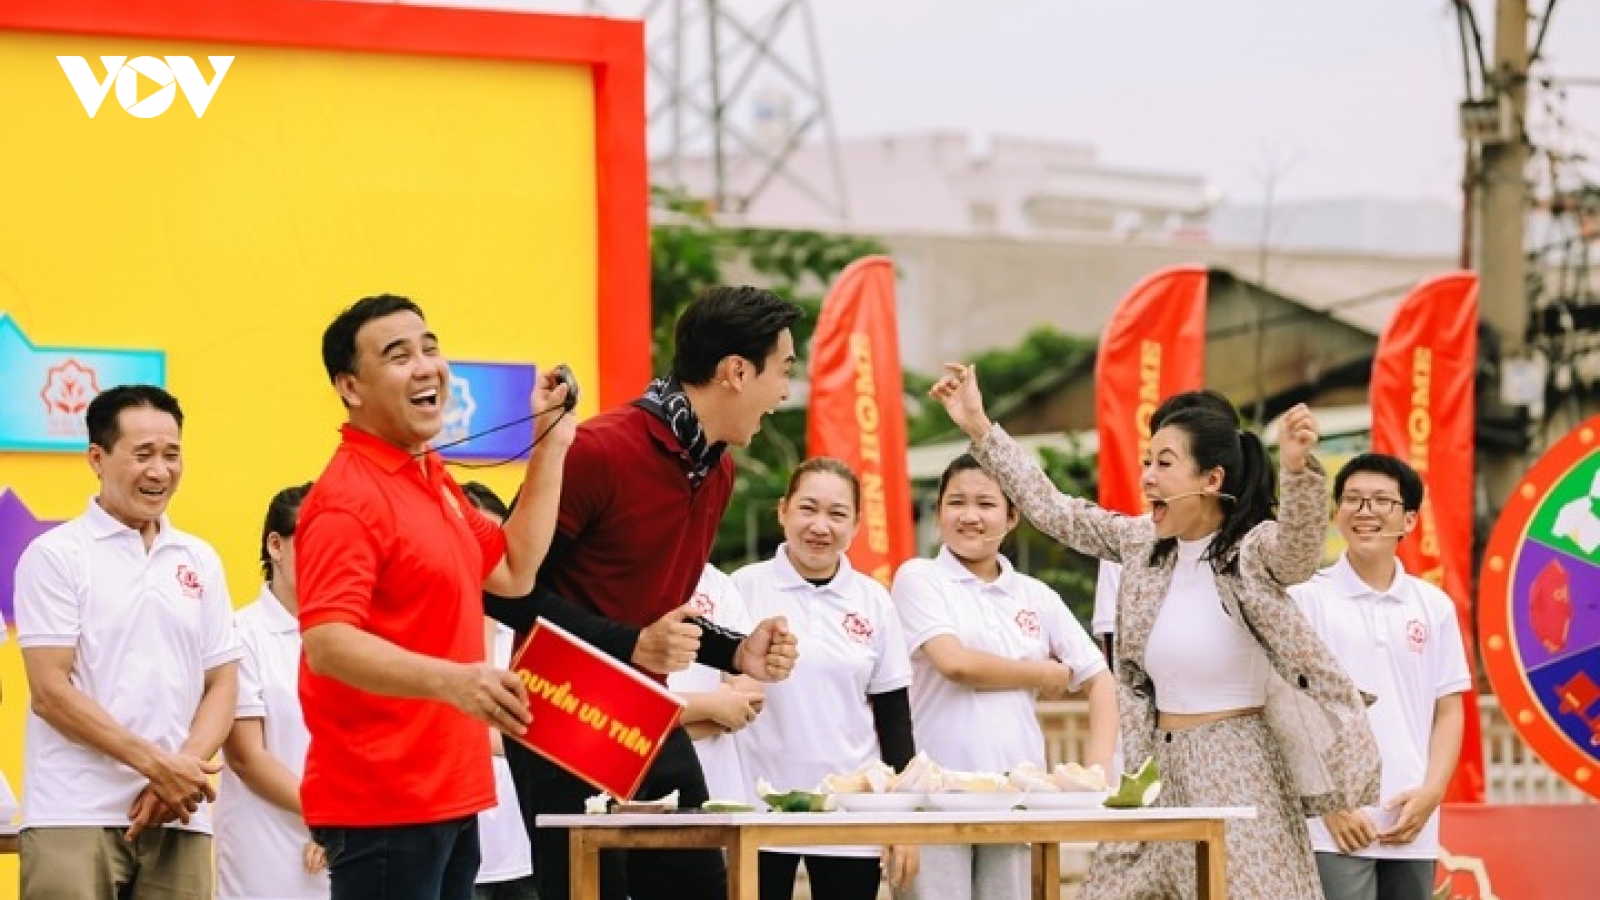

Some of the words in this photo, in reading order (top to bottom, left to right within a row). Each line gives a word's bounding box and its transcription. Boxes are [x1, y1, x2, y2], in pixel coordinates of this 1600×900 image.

[849, 333, 882, 464] HOME
[1407, 346, 1432, 473] HOME
[861, 473, 890, 554] SEN
[1419, 484, 1441, 557] SE
[608, 720, 652, 757] TIÊN
